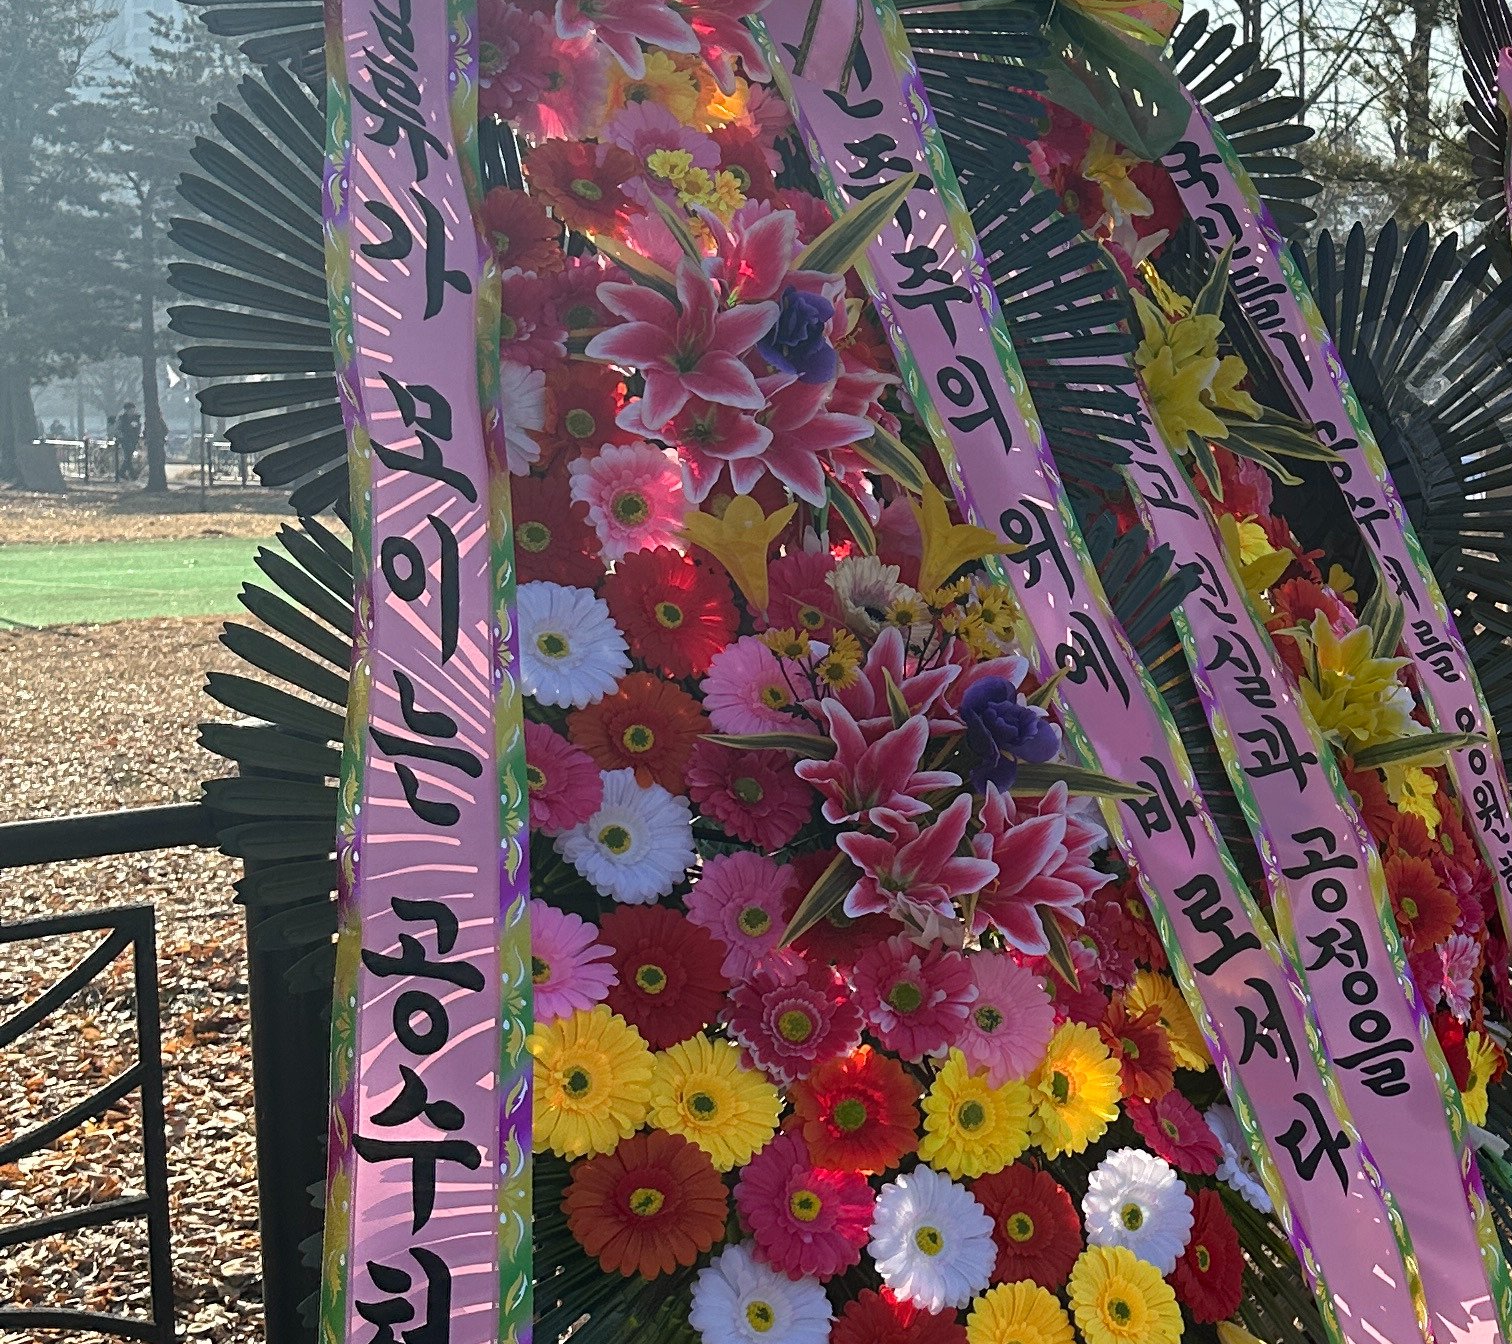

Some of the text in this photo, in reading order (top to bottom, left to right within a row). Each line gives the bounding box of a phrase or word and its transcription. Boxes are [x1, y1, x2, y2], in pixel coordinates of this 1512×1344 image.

[369, 370, 483, 826] 모이는
[1000, 497, 1131, 708] 위에
[1282, 827, 1415, 1098] 공정을
